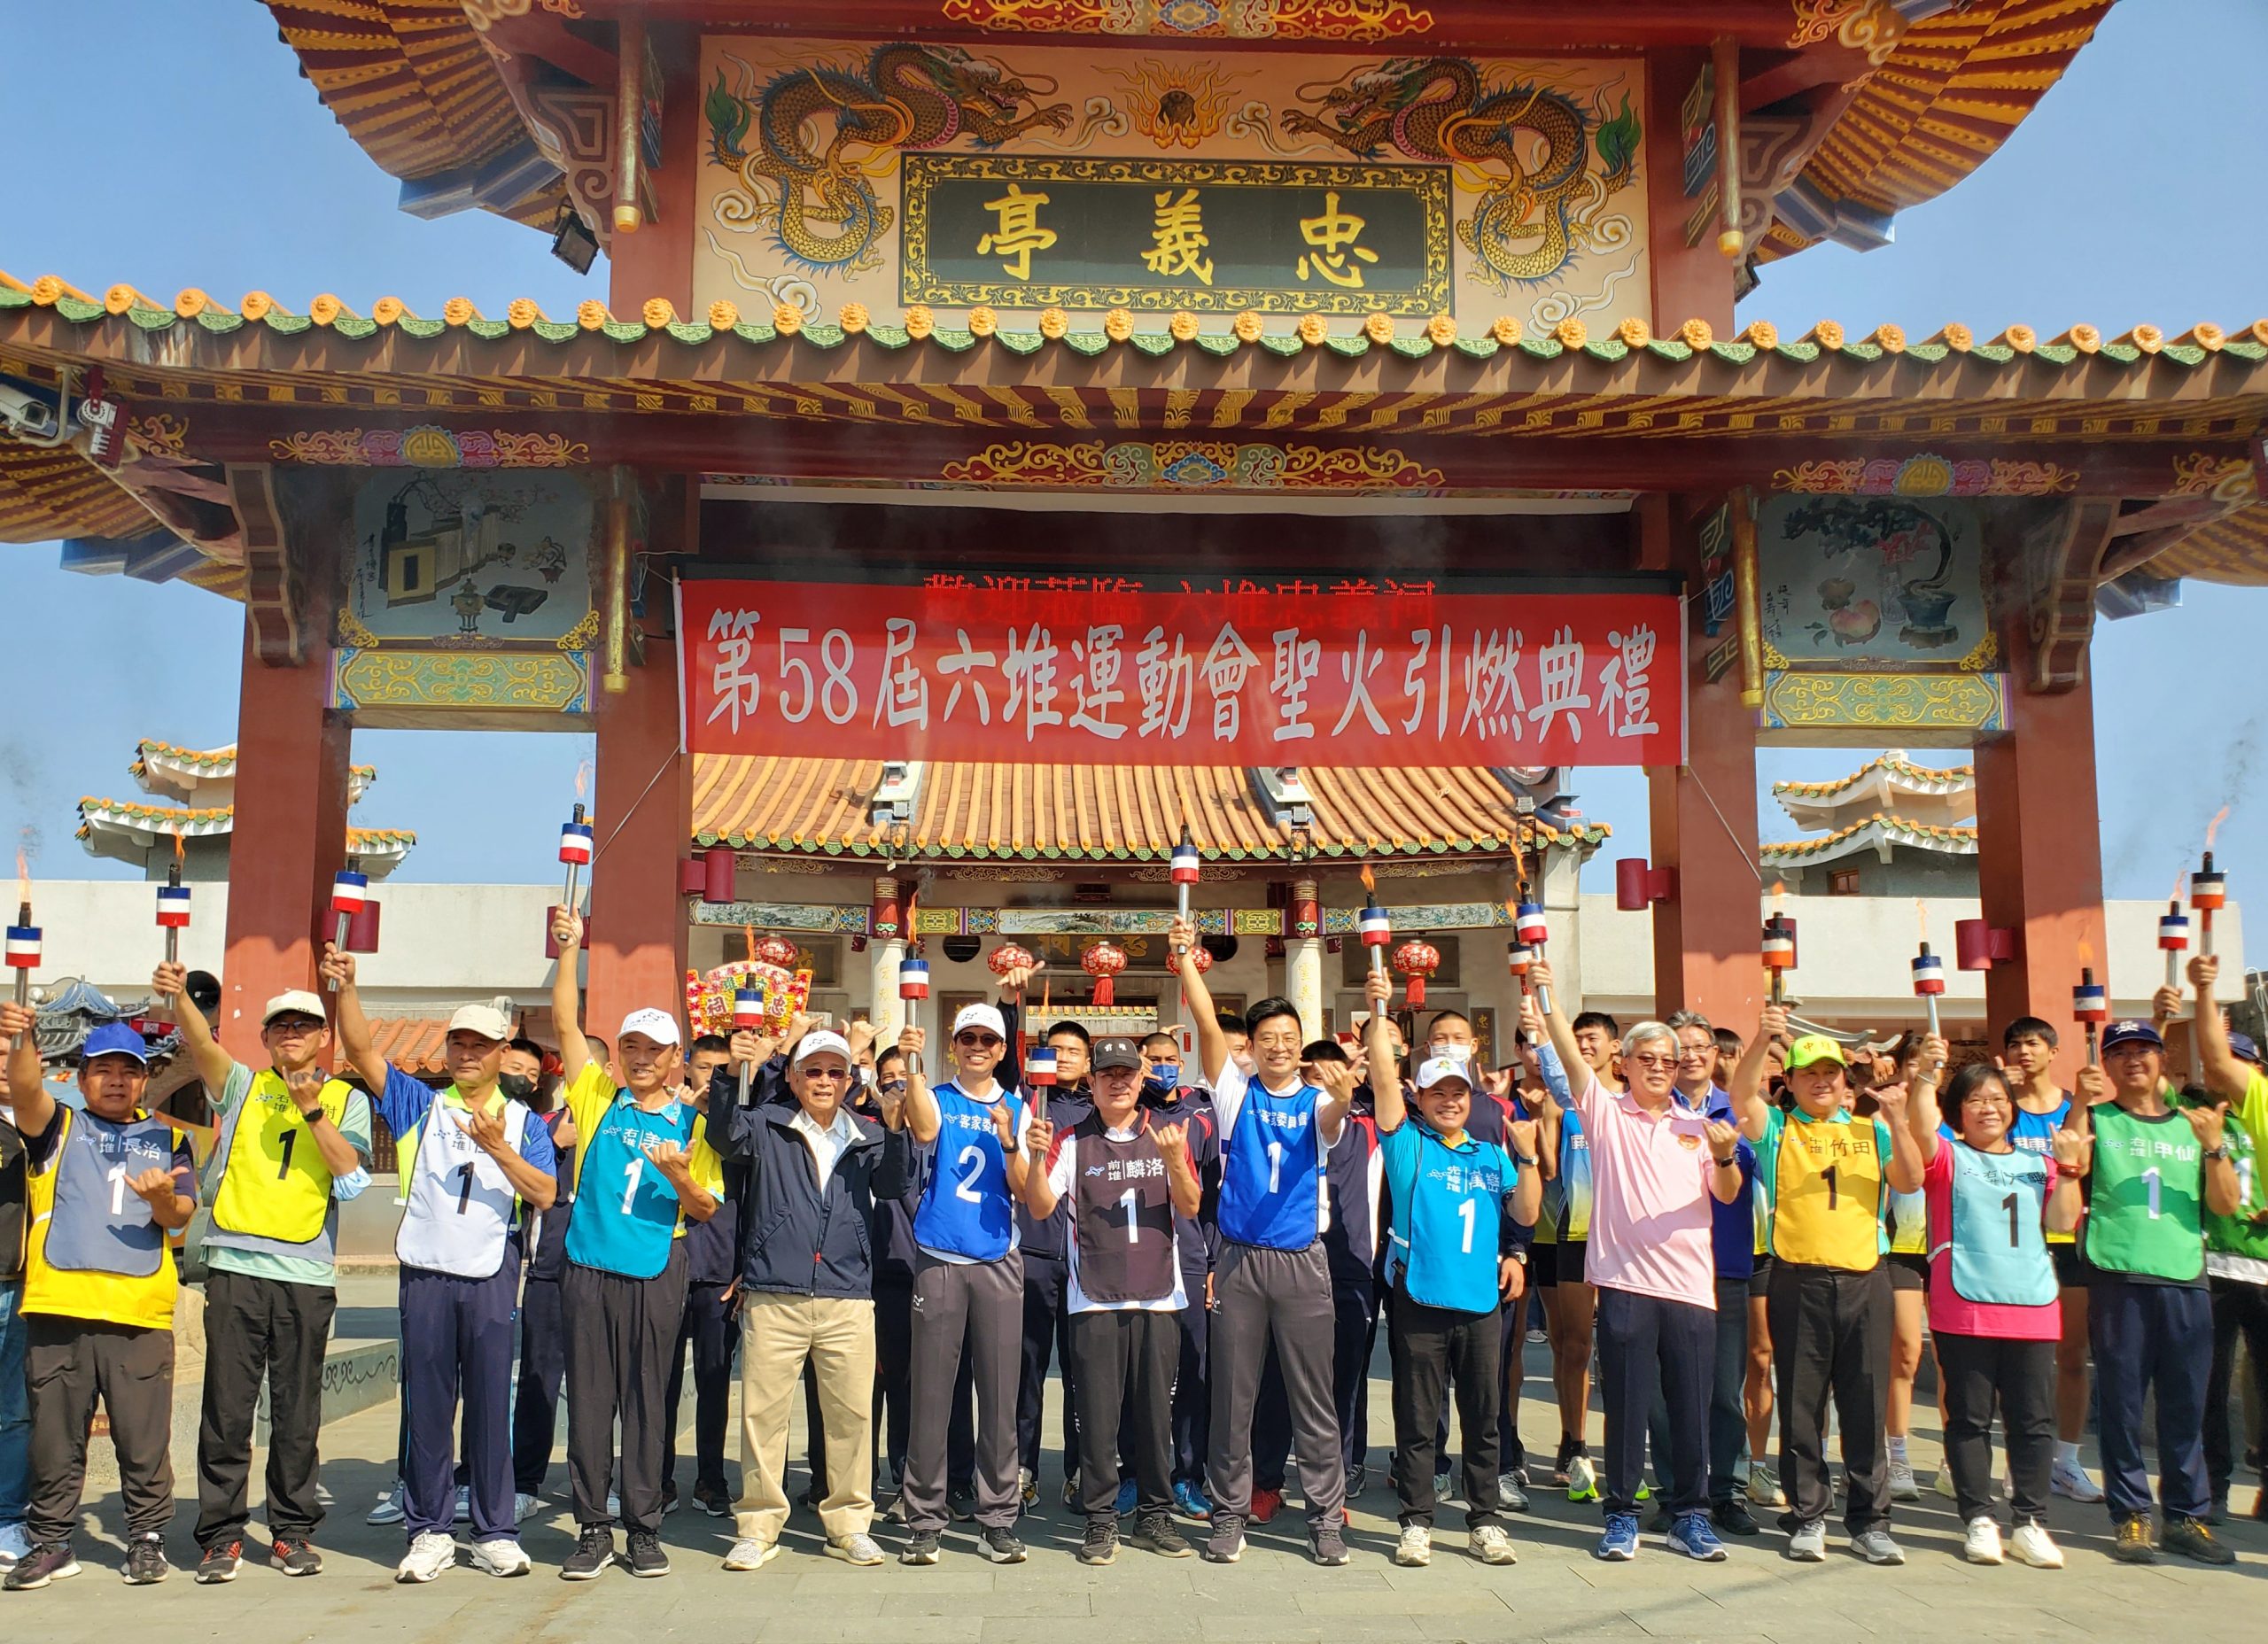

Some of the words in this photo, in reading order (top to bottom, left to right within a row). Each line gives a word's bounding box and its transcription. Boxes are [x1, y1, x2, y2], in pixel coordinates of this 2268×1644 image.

[976, 182, 1379, 288] 忠義亭
[707, 608, 1659, 742] 第58屆六堆運動會聖火引燃典禮
[122, 1137, 162, 1160] 長治
[277, 1128, 298, 1181] 1
[956, 1145, 986, 1203] 2
[1126, 1158, 1165, 1179] 麟洛
[1267, 1141, 1283, 1194] 1
[1830, 1138, 1870, 1157] 竹田
[2155, 1141, 2195, 1161] 甲仙
[107, 1161, 127, 1215] 1
[457, 1160, 475, 1215] 1
[622, 1158, 644, 1214] 1
[1821, 1165, 1837, 1211] 1
[2141, 1167, 2160, 1220] 1
[1120, 1188, 1138, 1244] 1
[1458, 1198, 1475, 1253] 1
[2002, 1192, 2019, 1248] 1
